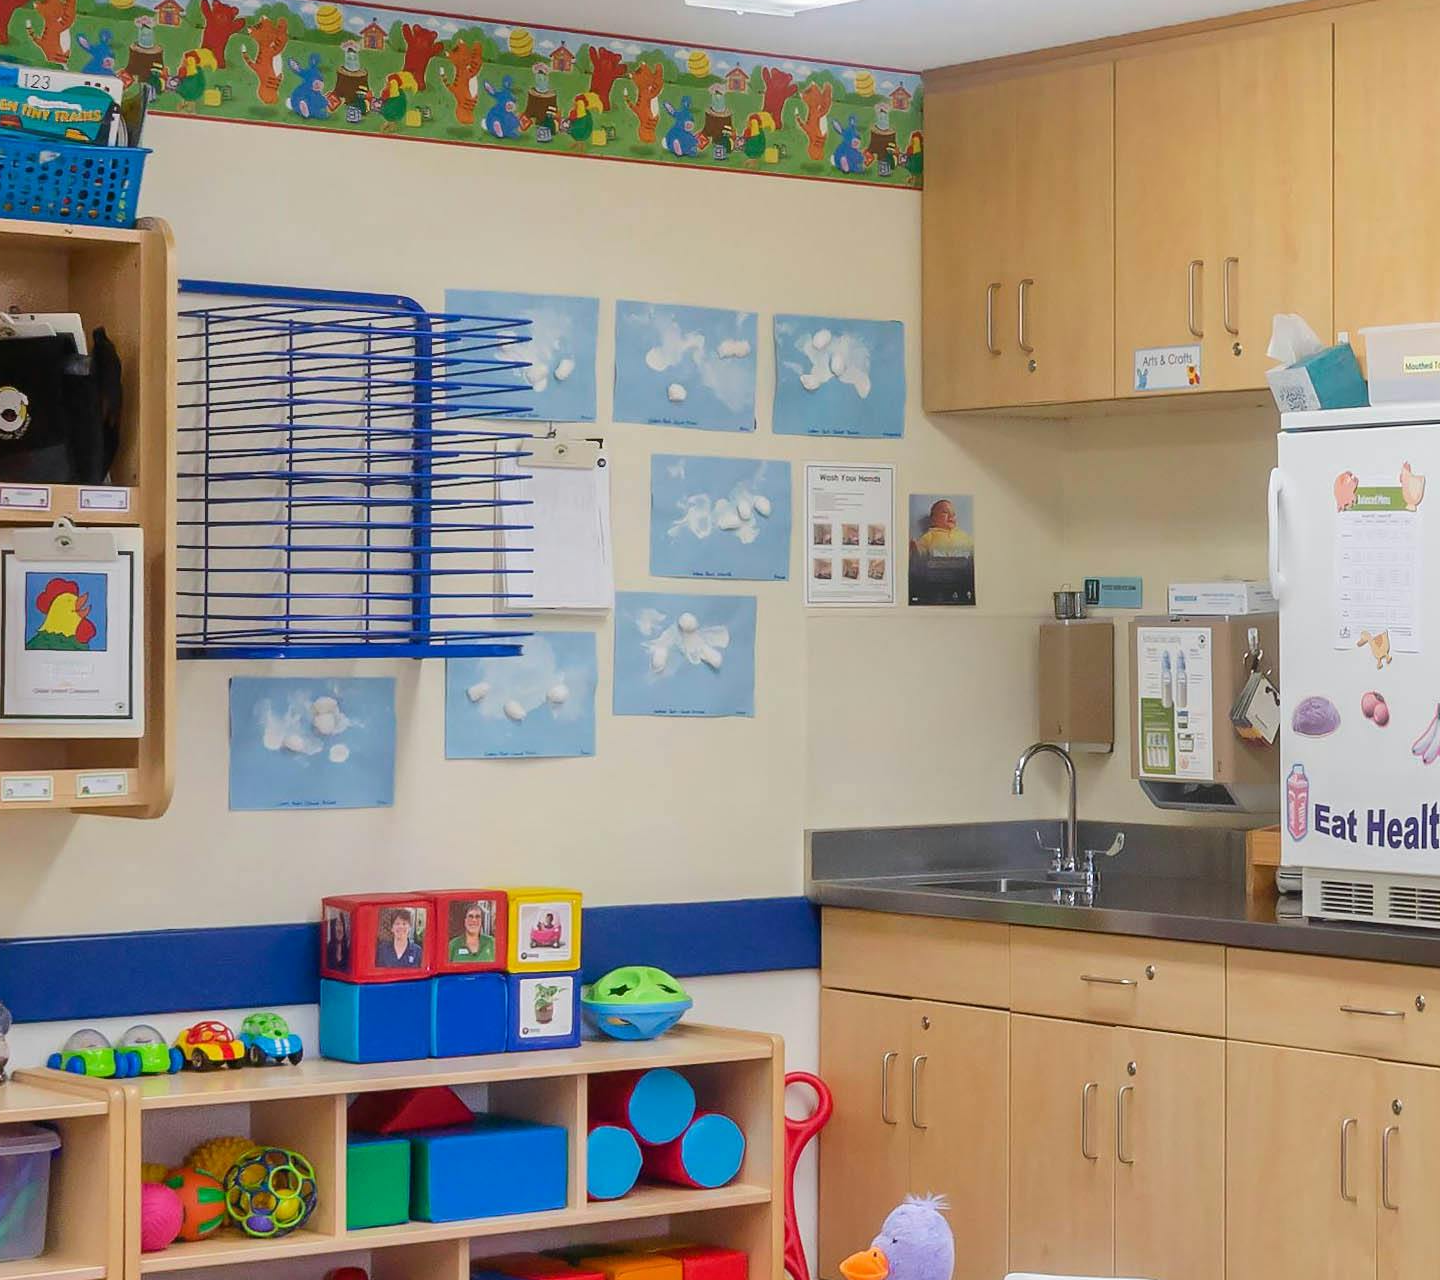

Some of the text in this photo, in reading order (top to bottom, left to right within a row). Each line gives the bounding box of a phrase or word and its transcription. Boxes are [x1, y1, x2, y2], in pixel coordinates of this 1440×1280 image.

[22, 73, 51, 90] 123
[22, 103, 51, 121] TINY
[1142, 353, 1193, 367] Arts & Crafts
[1405, 361, 1433, 370] Mouthed
[819, 473, 881, 483] Wash Your Hands
[1314, 803, 1357, 843] Eat
